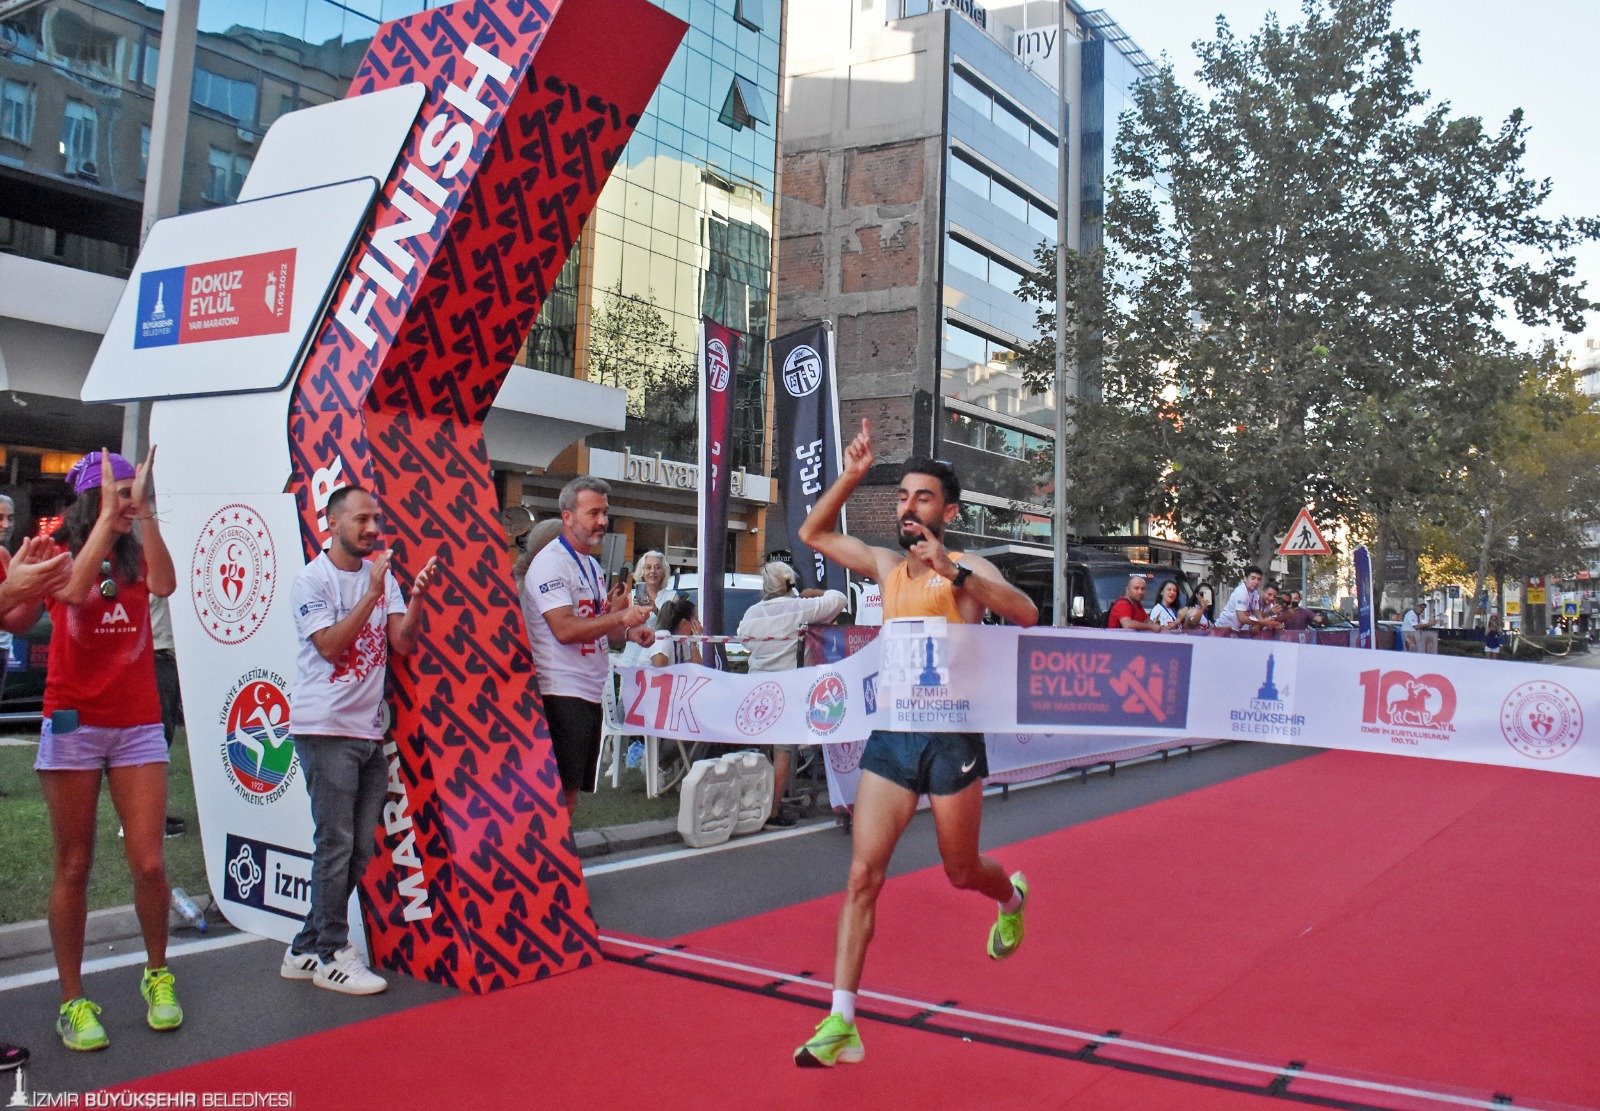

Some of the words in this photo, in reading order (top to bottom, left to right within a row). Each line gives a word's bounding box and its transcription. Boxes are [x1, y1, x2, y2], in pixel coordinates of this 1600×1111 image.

[1016, 29, 1057, 59] my
[335, 41, 513, 351] FINISH
[191, 270, 244, 296] DOKUZ
[276, 262, 288, 317] 11.09.2022
[189, 291, 235, 317] EYLÜL
[227, 529, 250, 543] GENÇLİK
[769, 554, 792, 563] bulvar
[866, 594, 882, 602] TÜR
[1030, 650, 1112, 673] DOKUZ
[219, 686, 238, 727] TÜRKİYE
[237, 667, 268, 688] ATLETİZM
[1029, 674, 1102, 698] EYLÜL
[895, 698, 970, 711] BÜYÜKŞEHİR
[898, 711, 967, 723] BELEDİYESİ
[1230, 710, 1306, 726] BÜYÜKŞEHİR
[1232, 723, 1301, 736] BELEDİYESİ
[220, 743, 236, 785] TURKISH
[234, 785, 264, 806] ATHLETIC
[265, 756, 301, 805] FEDERATION
[251, 781, 264, 791] 1922
[274, 862, 312, 902] izm
